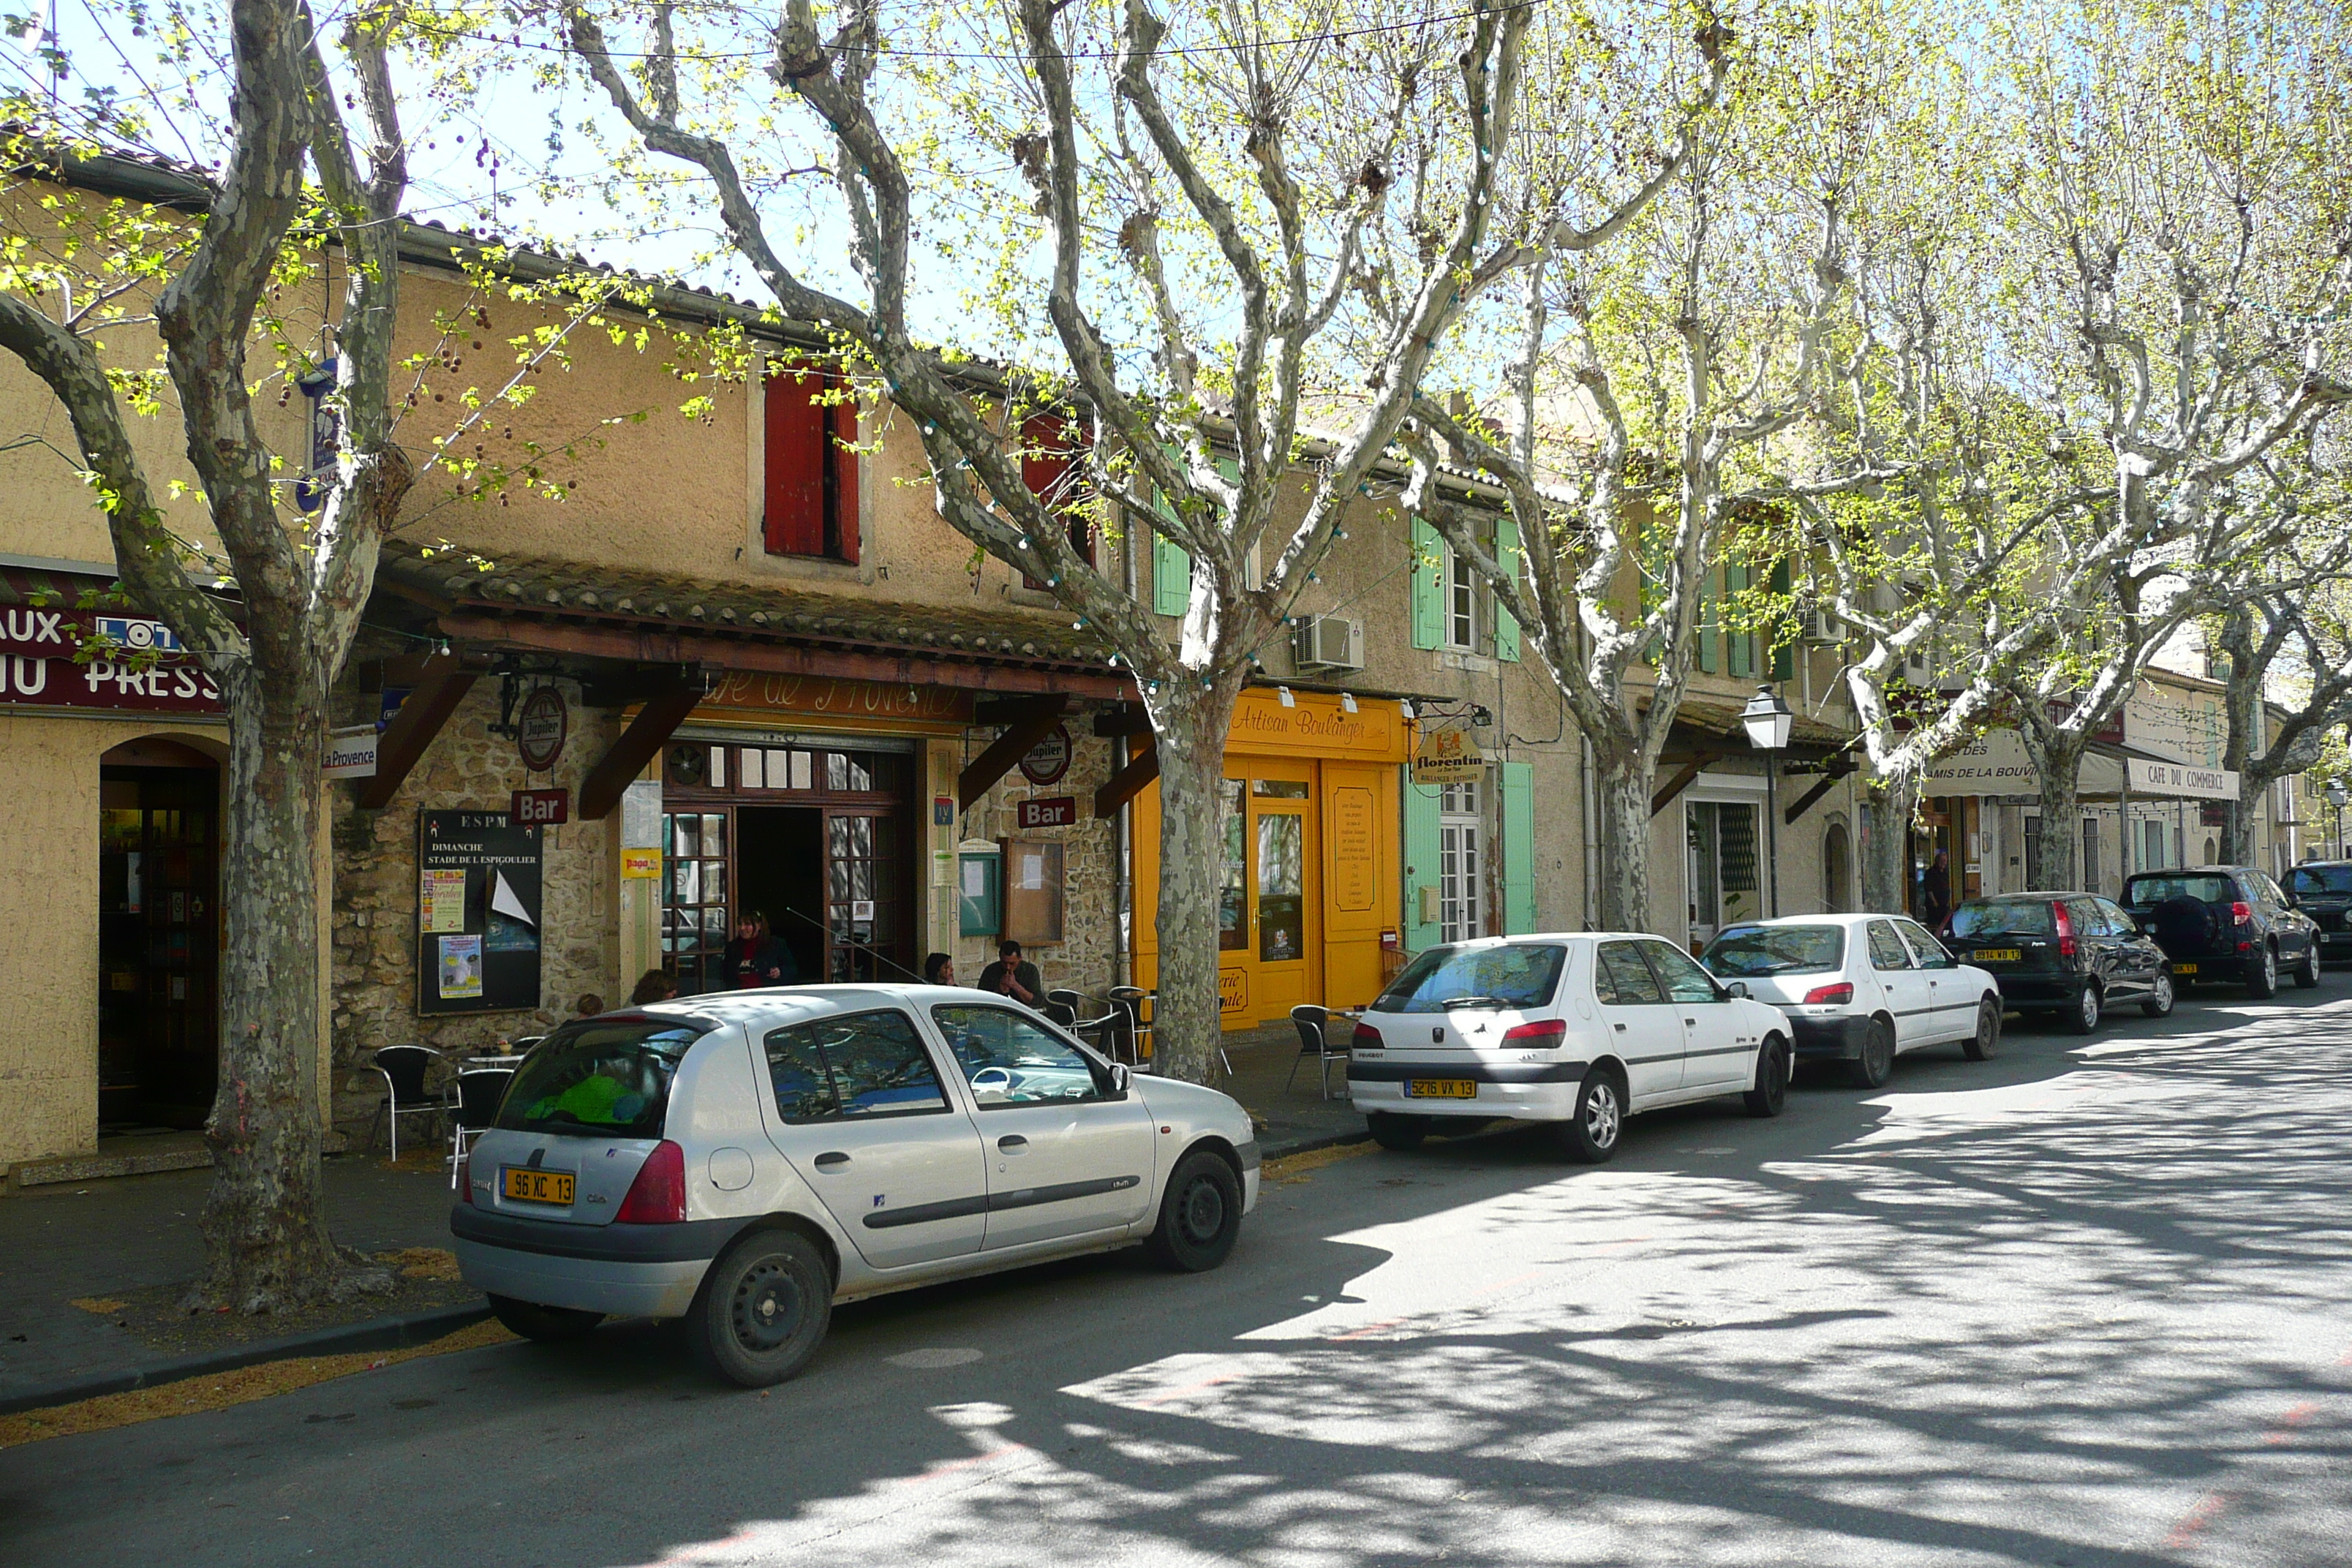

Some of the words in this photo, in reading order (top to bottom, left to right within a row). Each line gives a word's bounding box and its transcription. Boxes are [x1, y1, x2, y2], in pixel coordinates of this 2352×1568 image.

[527, 720, 558, 737] Jupiler
[1231, 705, 1289, 733] Artisan
[1295, 710, 1365, 745] Boulanger
[1028, 744, 1062, 759] Jupiler
[1963, 745, 1988, 755] DES
[322, 753, 331, 766] La
[333, 750, 374, 766] Provence
[1957, 768, 1975, 778] DE
[1977, 768, 1992, 777] LA
[2148, 766, 2166, 784] CAFE
[2171, 769, 2181, 786] DU
[2187, 771, 2223, 790] COMMERCE
[520, 795, 559, 821] Bar
[1026, 804, 1064, 825] Bar
[432, 843, 483, 852] DIMANCHE
[480, 856, 536, 864] ESPIGOULIER
[1975, 951, 1994, 960] 9914
[2011, 950, 2020, 959] 13
[1218, 973, 1240, 988] erie
[1224, 992, 1243, 1007] ale
[1412, 1081, 1437, 1095] 5276
[1441, 1082, 1455, 1095] VX
[1462, 1082, 1473, 1096] 13
[516, 1174, 529, 1196] 96
[533, 1176, 548, 1198] XC
[557, 1178, 571, 1200] 13
